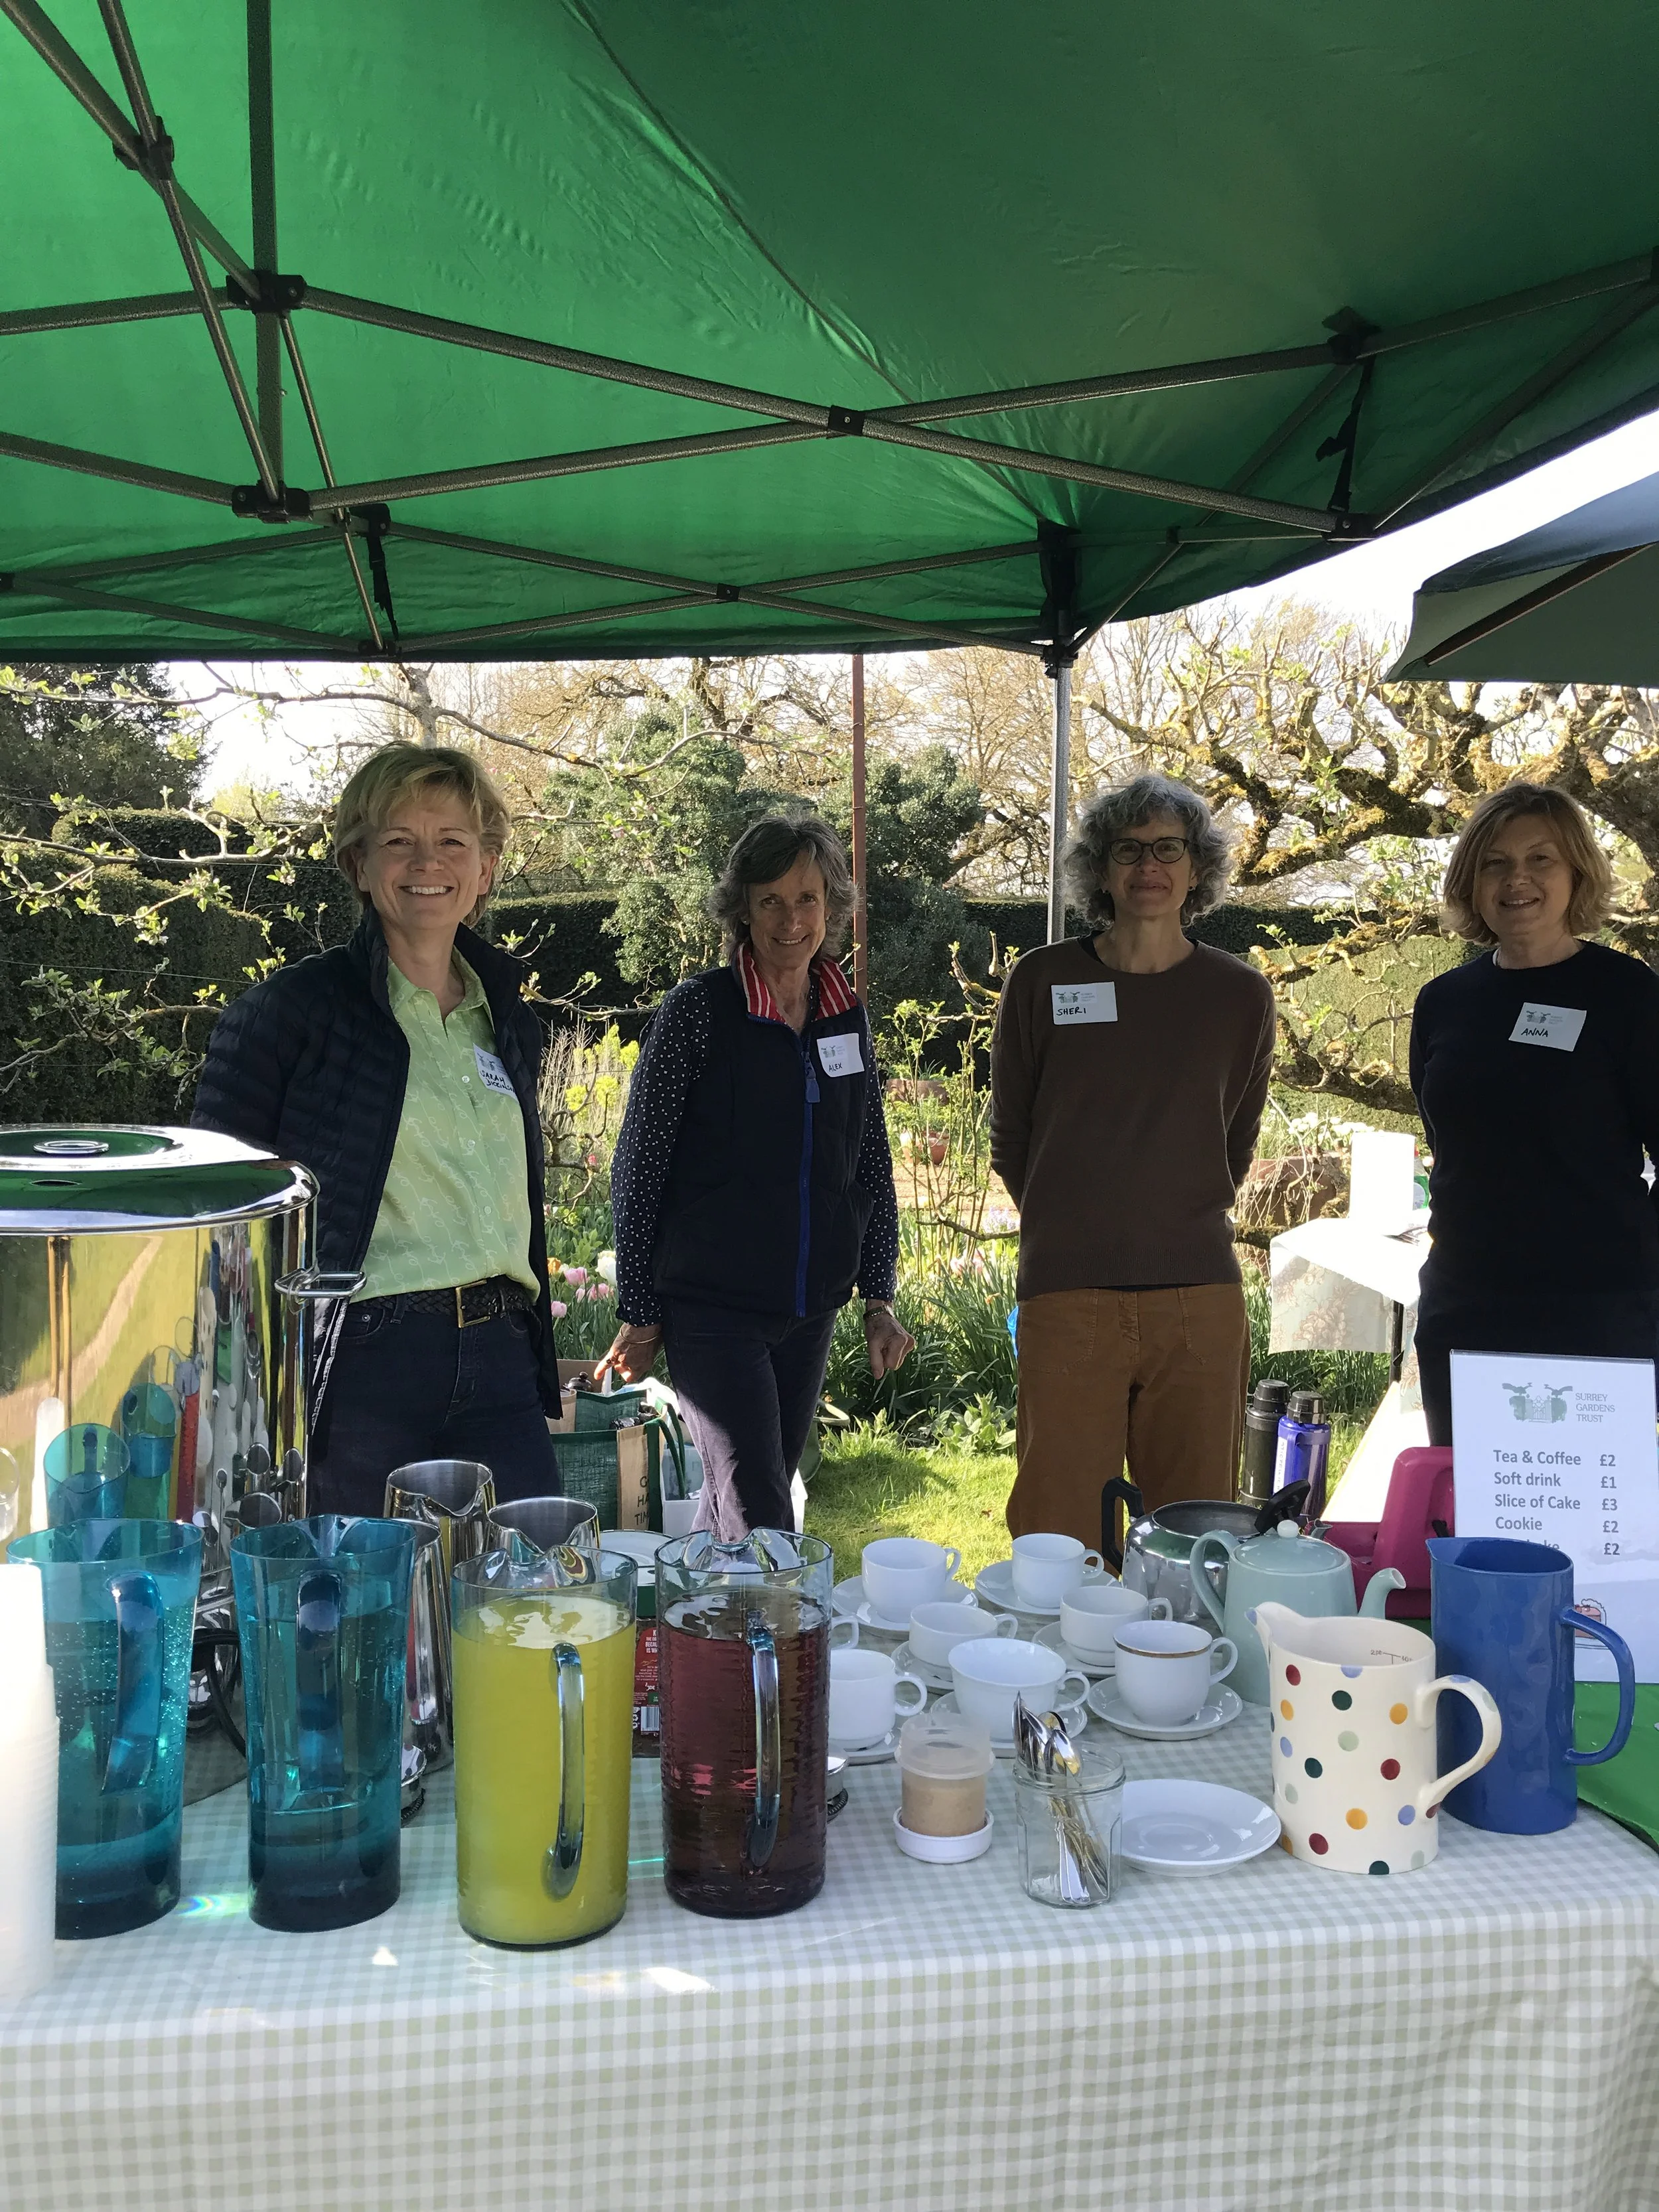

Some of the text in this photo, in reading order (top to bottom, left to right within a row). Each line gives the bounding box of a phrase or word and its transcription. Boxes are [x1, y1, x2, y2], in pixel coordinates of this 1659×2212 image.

[1056, 1007, 1086, 1016] SHERI
[1521, 1028, 1549, 1037] ANNA
[829, 1063, 843, 1072] ALEX
[480, 1070, 506, 1086] SARAH
[1575, 1393, 1608, 1402] SURREY
[1576, 1403, 1615, 1412] GARDENS
[1493, 1449, 1616, 1467] Tea & Coffee £2
[1494, 1471, 1617, 1489] Soft drink £1
[1494, 1493, 1618, 1511] Slice of Cake £3
[1495, 1516, 1619, 1532] Cookie £2
[1603, 1542, 1621, 1556] £2
